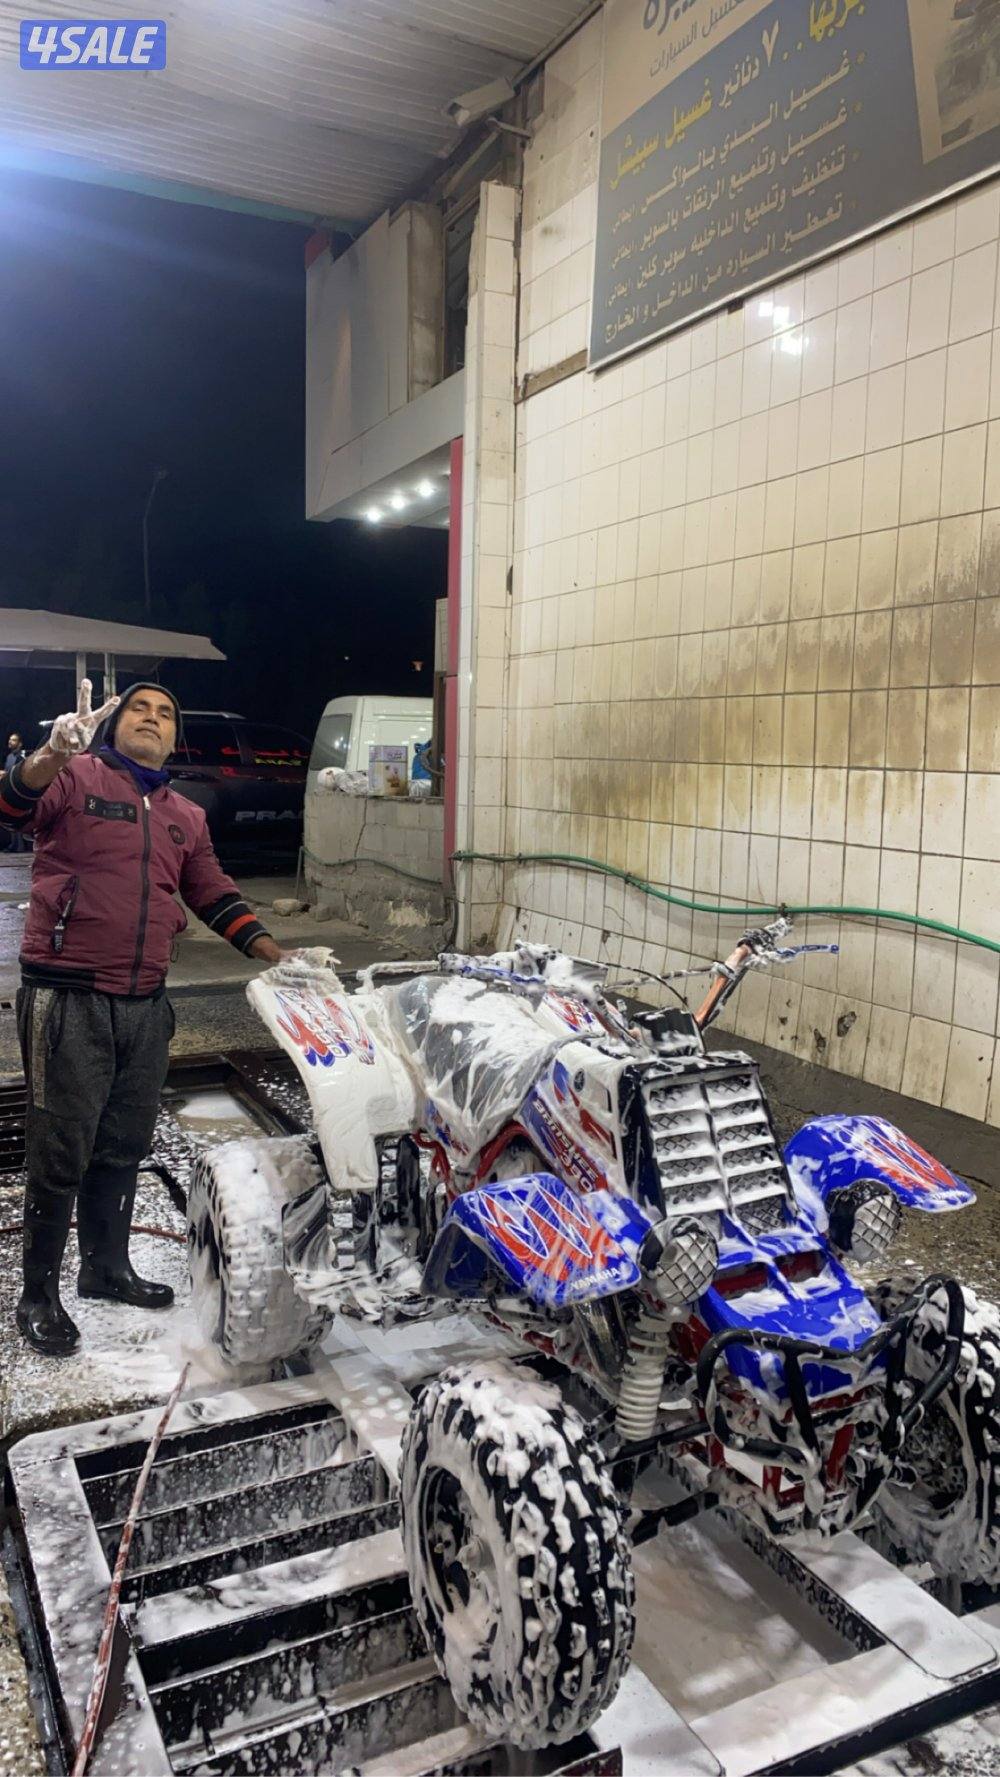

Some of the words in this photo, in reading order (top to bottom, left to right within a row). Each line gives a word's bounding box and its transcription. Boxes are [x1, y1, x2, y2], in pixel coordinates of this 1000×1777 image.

[719, 54, 760, 109] دنانير
[783, 49, 850, 120] غسيل
[665, 77, 712, 149] غسيل
[780, 99, 848, 165] غسيل
[728, 145, 777, 200] وتلميع
[743, 183, 787, 234] وتلميع
[780, 191, 843, 254] تعطير
[701, 265, 721, 293] من
[559, 1150, 594, 1193] 350
[570, 1266, 621, 1291] YAMAHA
